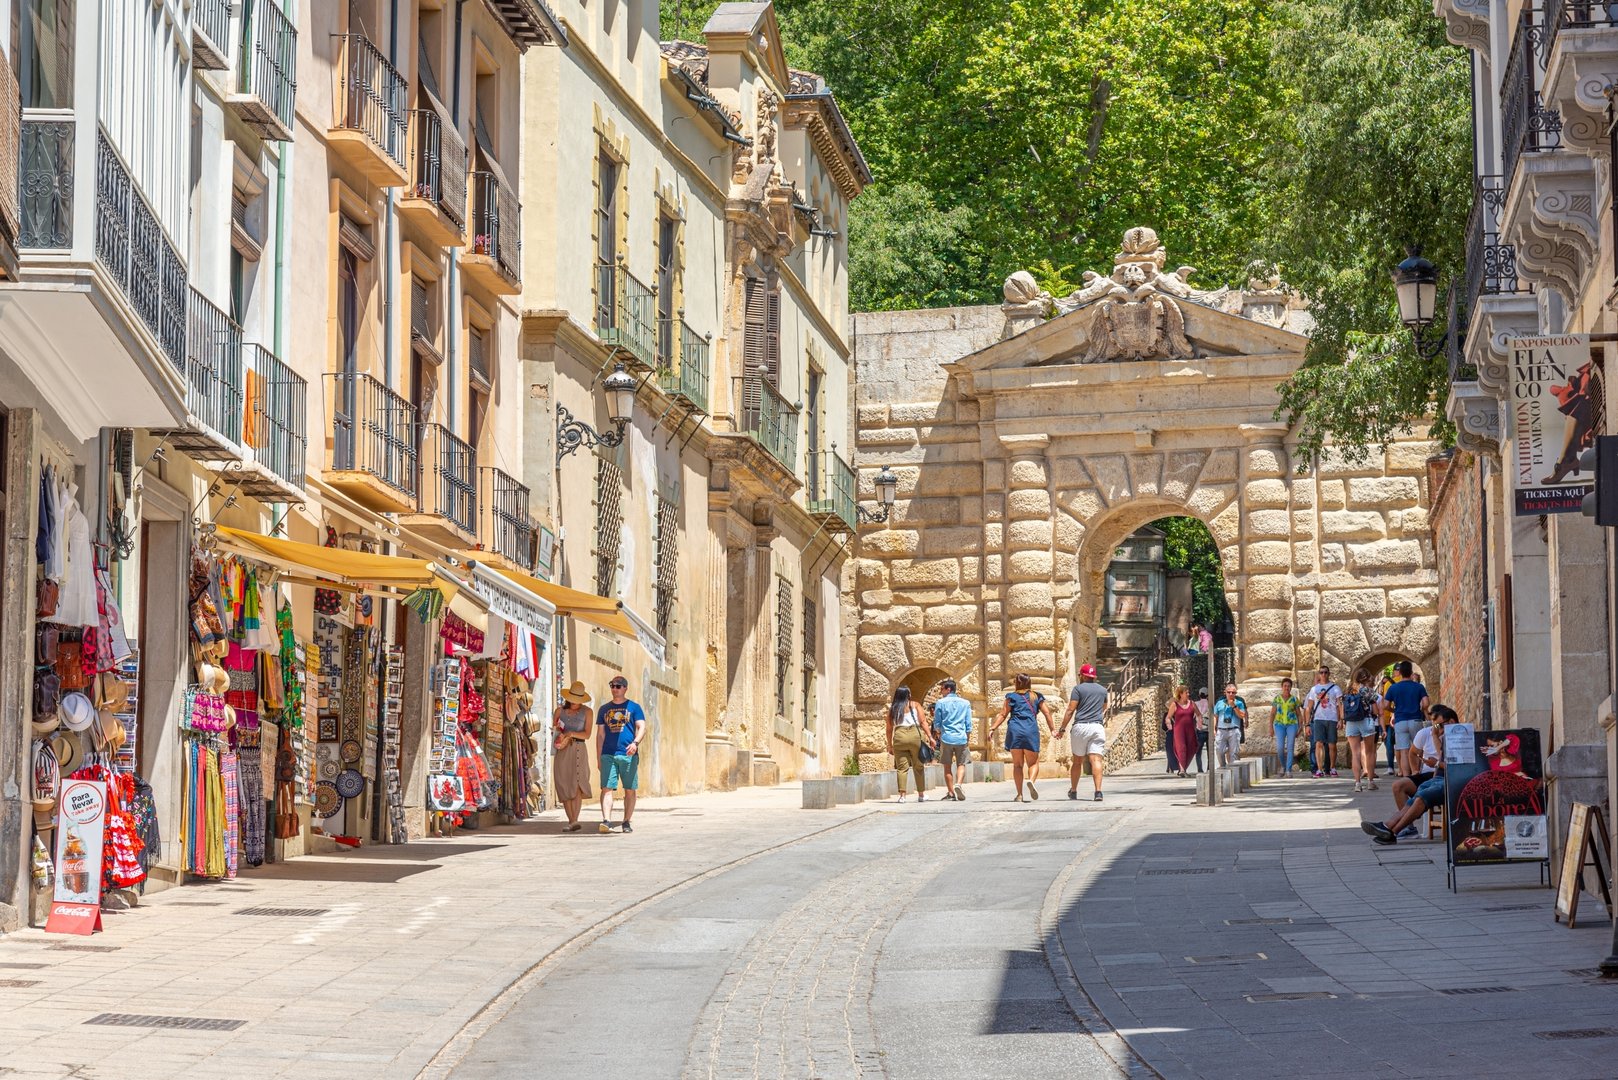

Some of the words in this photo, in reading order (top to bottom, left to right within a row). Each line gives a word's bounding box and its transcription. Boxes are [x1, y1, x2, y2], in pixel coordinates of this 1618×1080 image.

[1513, 335, 1582, 348] EXPOSICIÓN
[1514, 348, 1555, 365] FLA
[1514, 364, 1567, 382] MEN
[1515, 382, 1542, 399] CO
[1530, 400, 1543, 466] FLAMENCO
[1517, 402, 1533, 486] EXHIBITION
[1524, 489, 1562, 499] TICKETS
[1564, 486, 1585, 498] AQUÍ
[1523, 500, 1561, 510] TICKETS
[1563, 499, 1582, 508] HER
[71, 792, 90, 804] Para
[71, 798, 94, 811] llevar
[71, 808, 85, 817] Take
[85, 803, 100, 812] away
